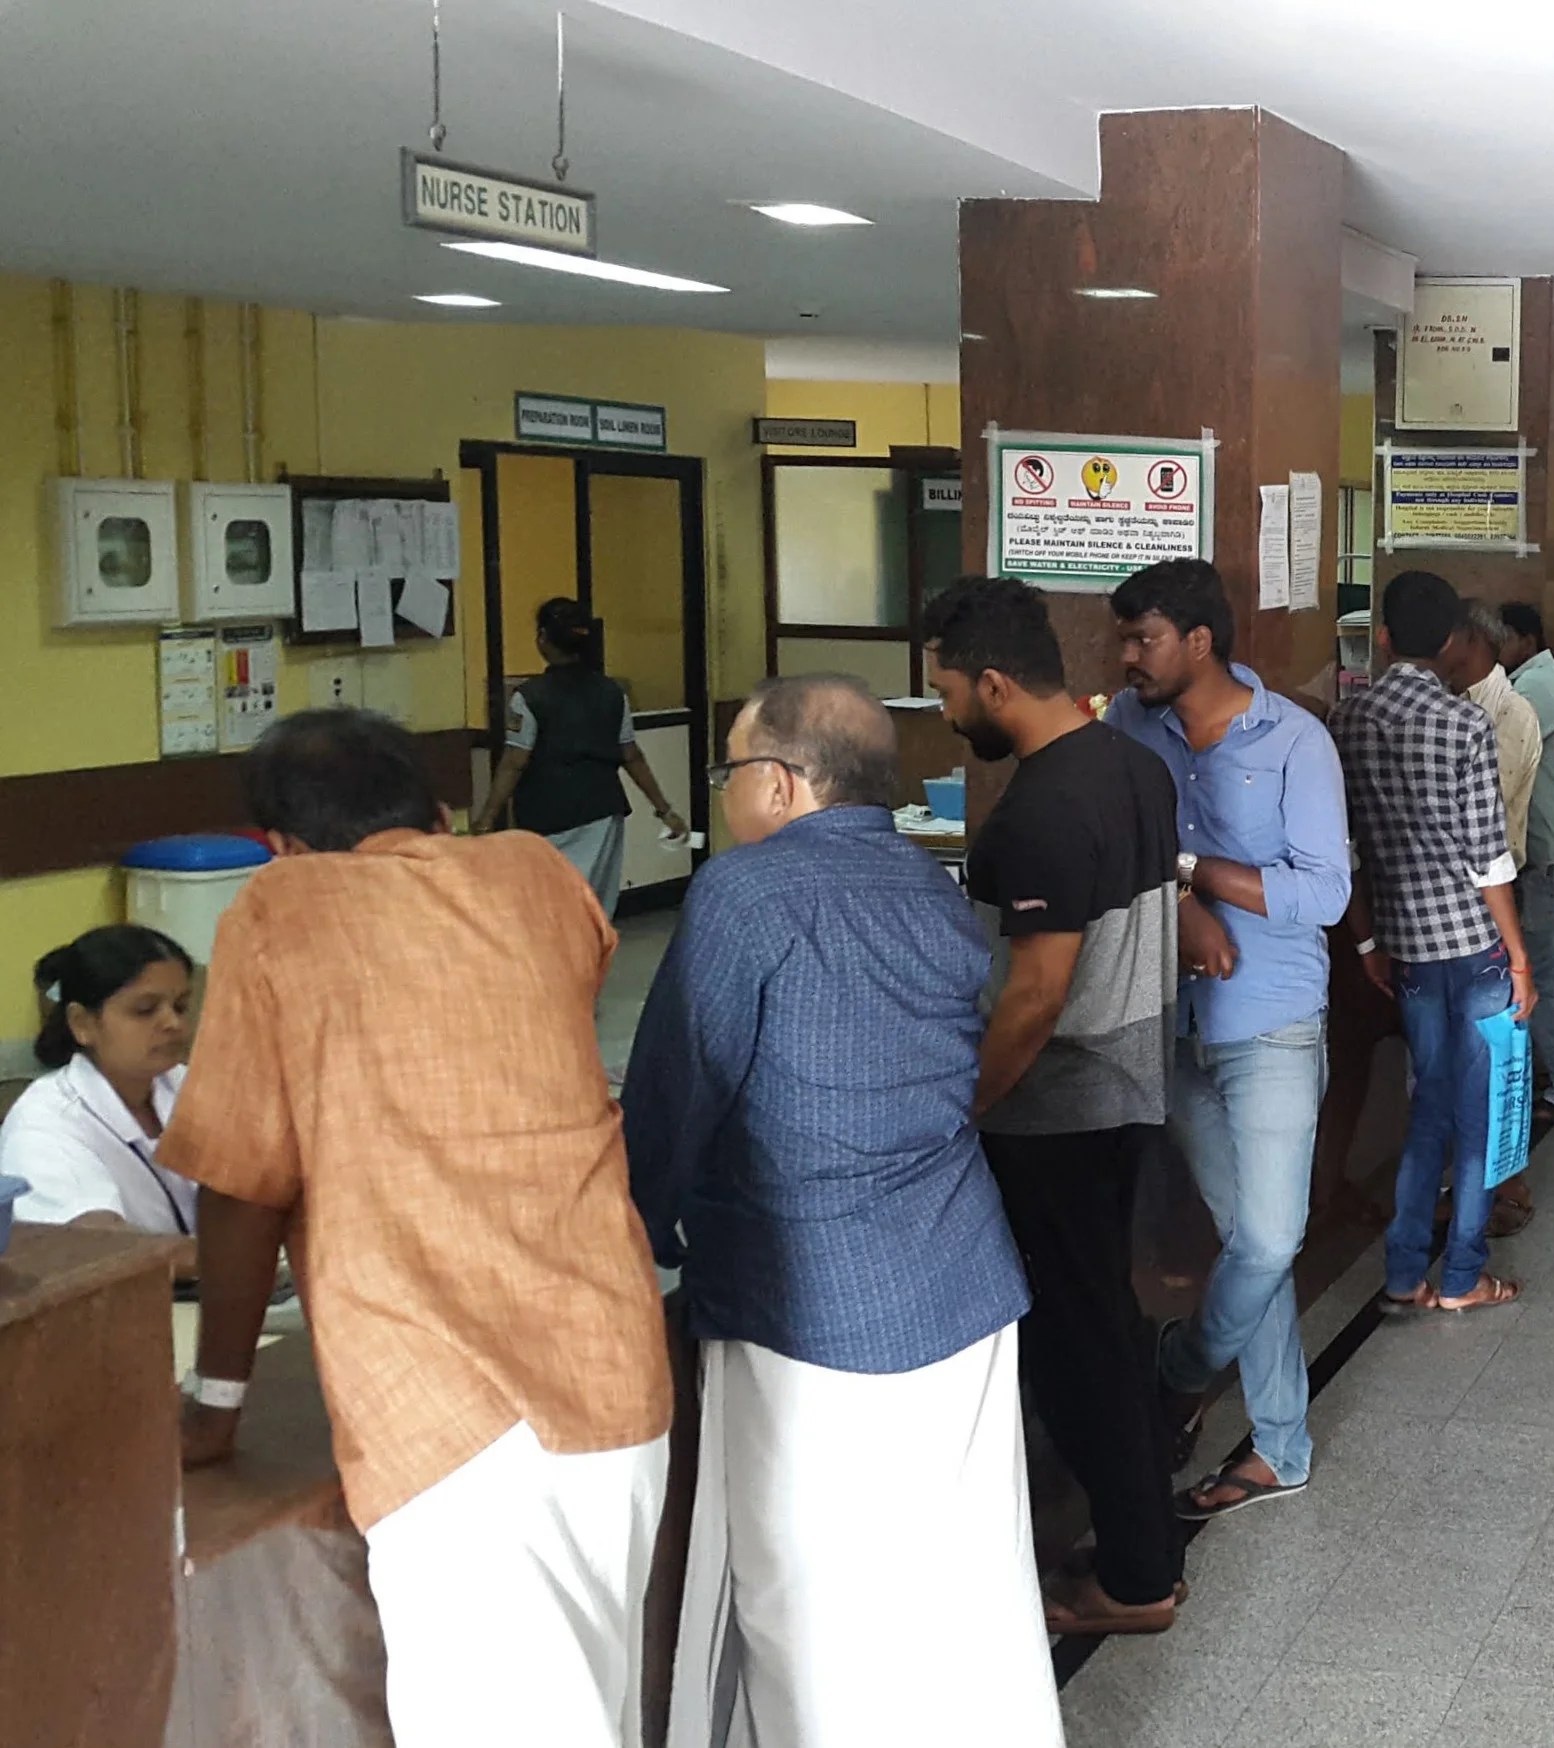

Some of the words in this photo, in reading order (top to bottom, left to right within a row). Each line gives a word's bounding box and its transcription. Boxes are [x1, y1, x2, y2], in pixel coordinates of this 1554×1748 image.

[421, 174, 489, 217] NURSE
[498, 190, 580, 234] STATION
[1009, 538, 1041, 546] PLEASE
[1043, 539, 1085, 547] MAINTAIN
[1087, 541, 1123, 549] SILENCE
[1126, 542, 1133, 550] &
[1134, 543, 1193, 552] CLEANLINESS
[1067, 563, 1119, 571] ELECTRICITY
